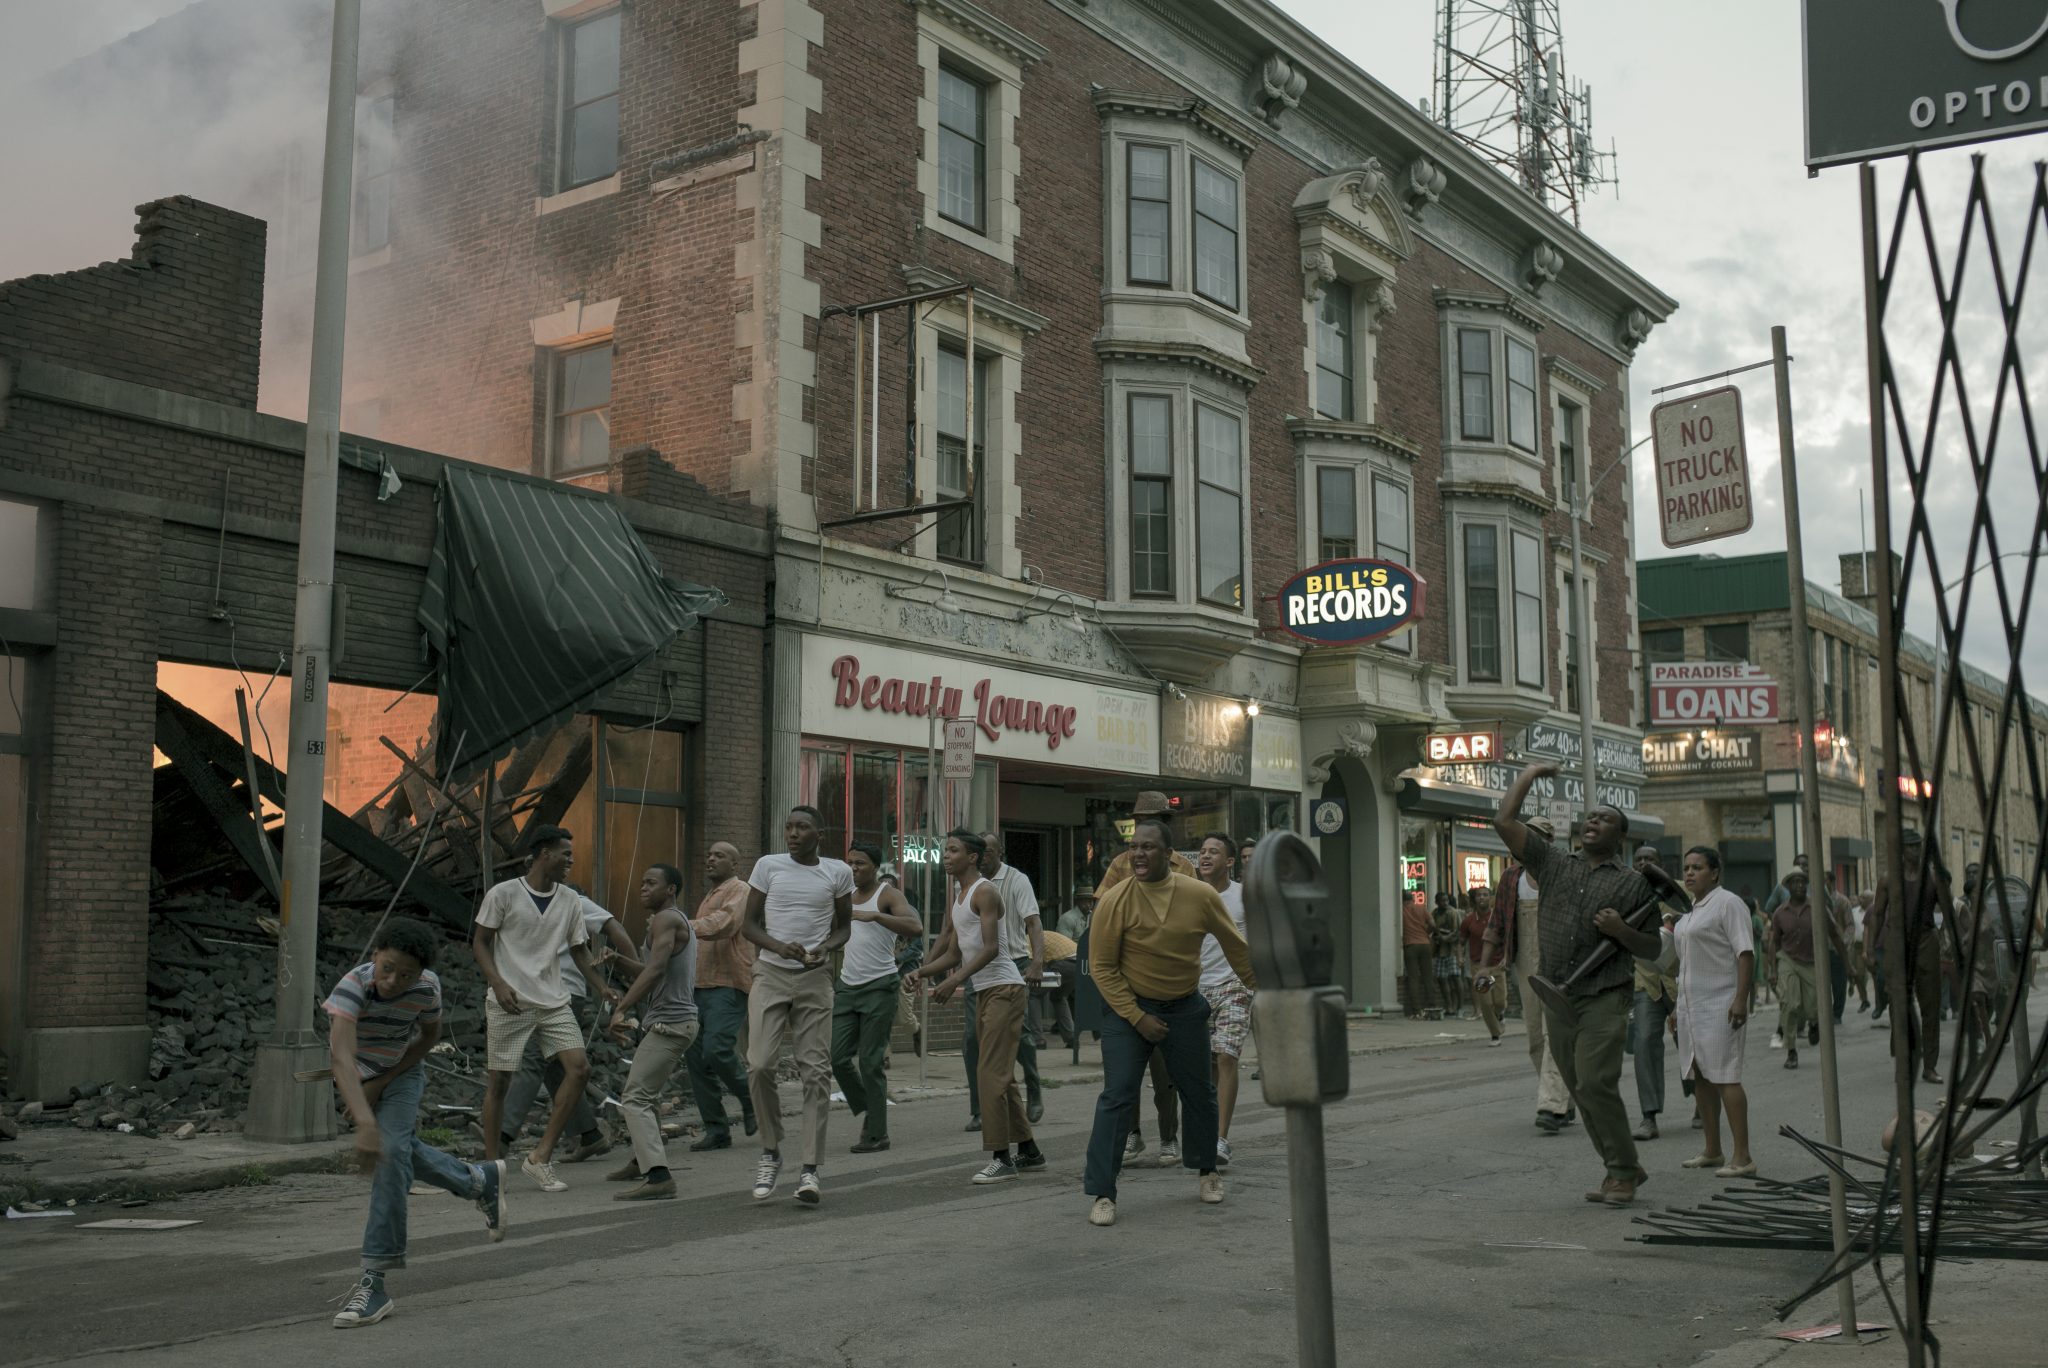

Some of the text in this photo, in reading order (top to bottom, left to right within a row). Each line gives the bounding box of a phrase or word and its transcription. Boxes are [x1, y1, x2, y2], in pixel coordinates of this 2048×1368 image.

[1909, 75, 2048, 128] OPTO
[1680, 415, 1713, 448] NO
[1663, 446, 1739, 487] TRUCK
[1666, 481, 1743, 524] PARKING
[1306, 568, 1388, 593] BILL'S
[1288, 583, 1407, 626] RECORDS
[1655, 665, 1743, 679] PARADISE
[832, 654, 1077, 750] Beauty Lounge
[1658, 687, 1770, 718] LOANS
[954, 727, 966, 738] NO
[1531, 726, 1556, 749] Save
[947, 742, 972, 750] STOPPING
[954, 753, 963, 761] OR
[1430, 735, 1490, 760] BAR
[1597, 746, 1640, 770] MERCHANDISE
[1642, 737, 1752, 763] CHIT CHAT
[945, 765, 971, 773] STANDING
[1166, 743, 1207, 773] RECORDS
[1213, 750, 1244, 777] BOOKS
[1645, 759, 1753, 772] NTERTAINMENT COCKTAILS
[1606, 786, 1636, 809] GOLD
[891, 835, 943, 849] BEAUY
